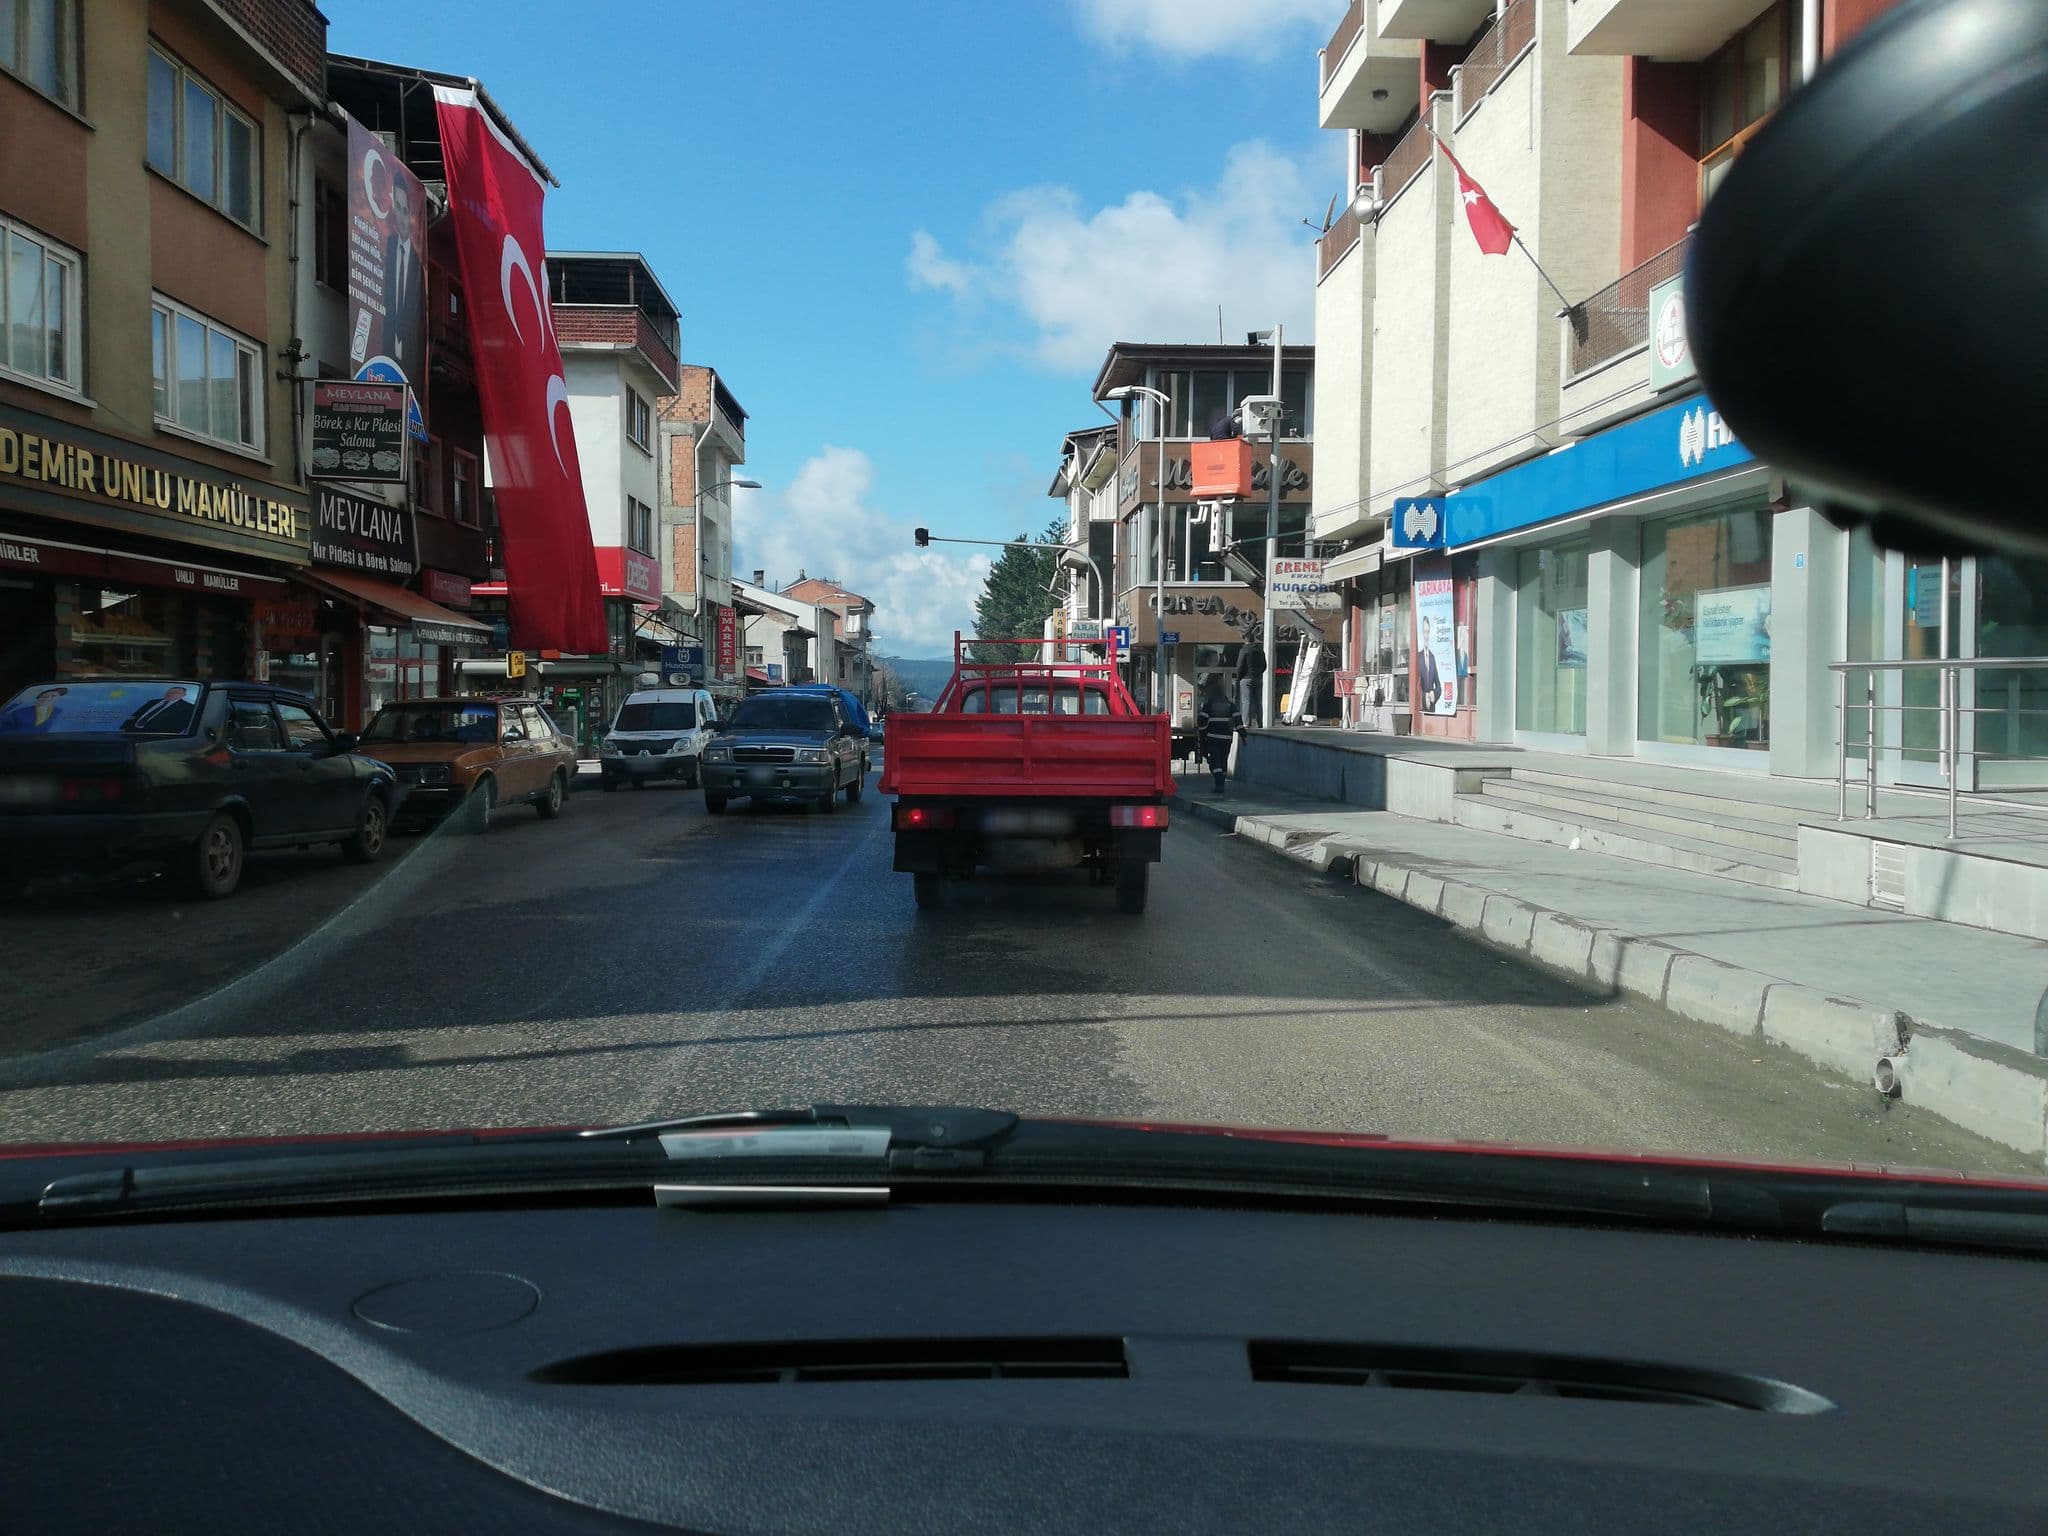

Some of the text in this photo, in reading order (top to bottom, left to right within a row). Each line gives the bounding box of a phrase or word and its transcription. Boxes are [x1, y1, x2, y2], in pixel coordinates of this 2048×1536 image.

[327, 388, 391, 401] MEVLANA
[314, 414, 342, 430] Börek
[354, 416, 369, 432] Kır
[372, 417, 401, 433] Pidesi
[340, 433, 375, 448] Salonu
[103, 455, 171, 509] UNLU
[177, 476, 296, 539] MAMÜLLERİ
[320, 492, 403, 545] MEVLANA
[313, 541, 412, 575] Kır Pidesi & Börek Salonu
[721, 617, 733, 664] MARKET
